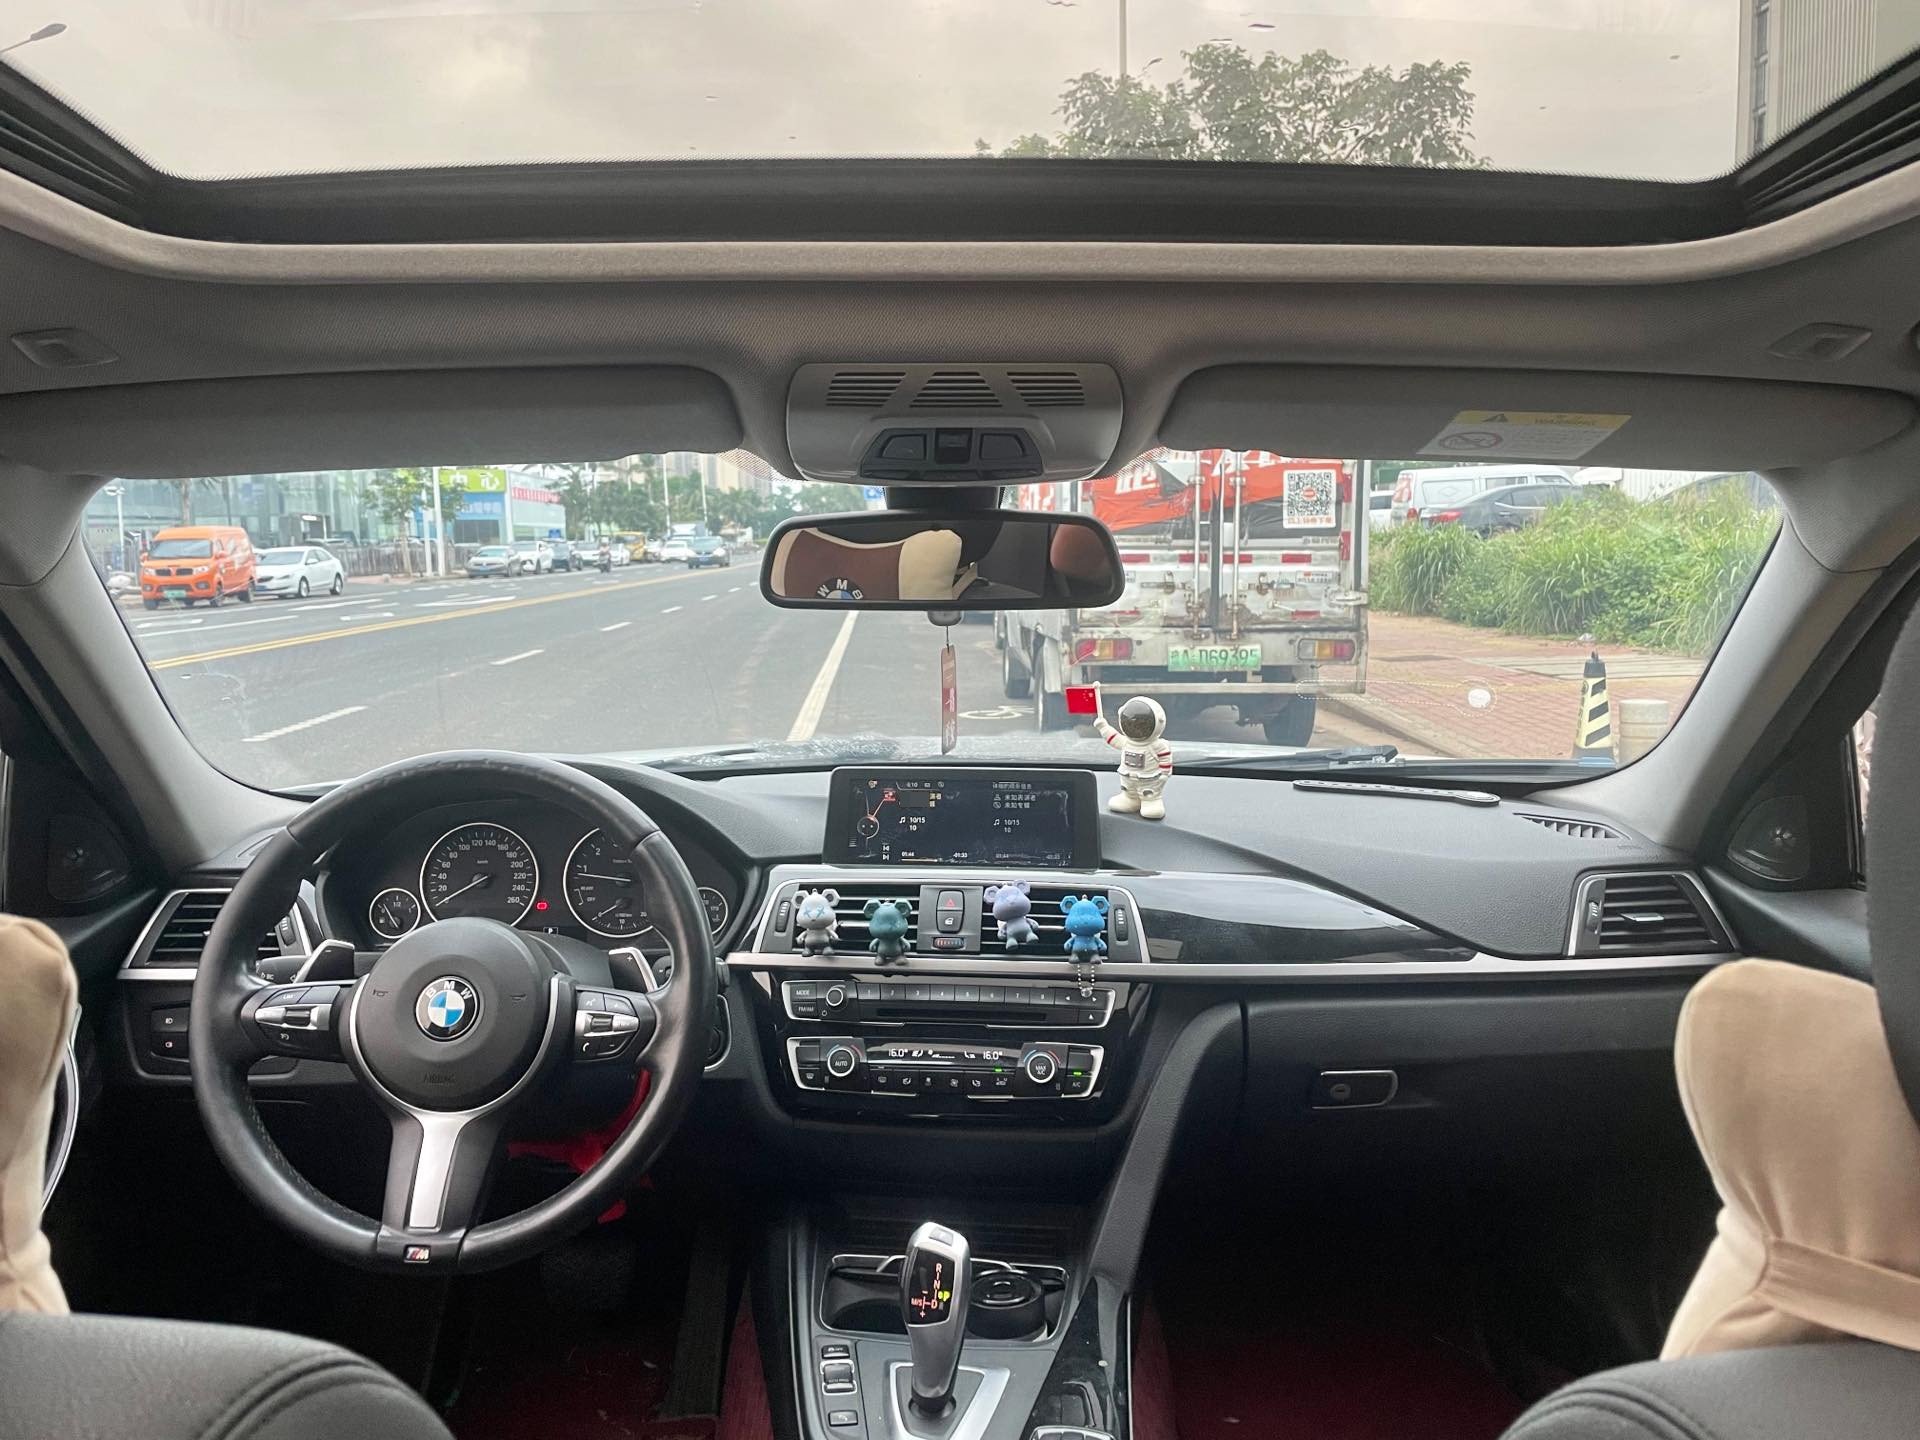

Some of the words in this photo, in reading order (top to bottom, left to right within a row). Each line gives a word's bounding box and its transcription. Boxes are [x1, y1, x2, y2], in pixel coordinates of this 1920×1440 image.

[425, 981, 472, 1000] BMW
[936, 1263, 942, 1272] R
[934, 1280, 940, 1289] N
[931, 1299, 937, 1309] D
